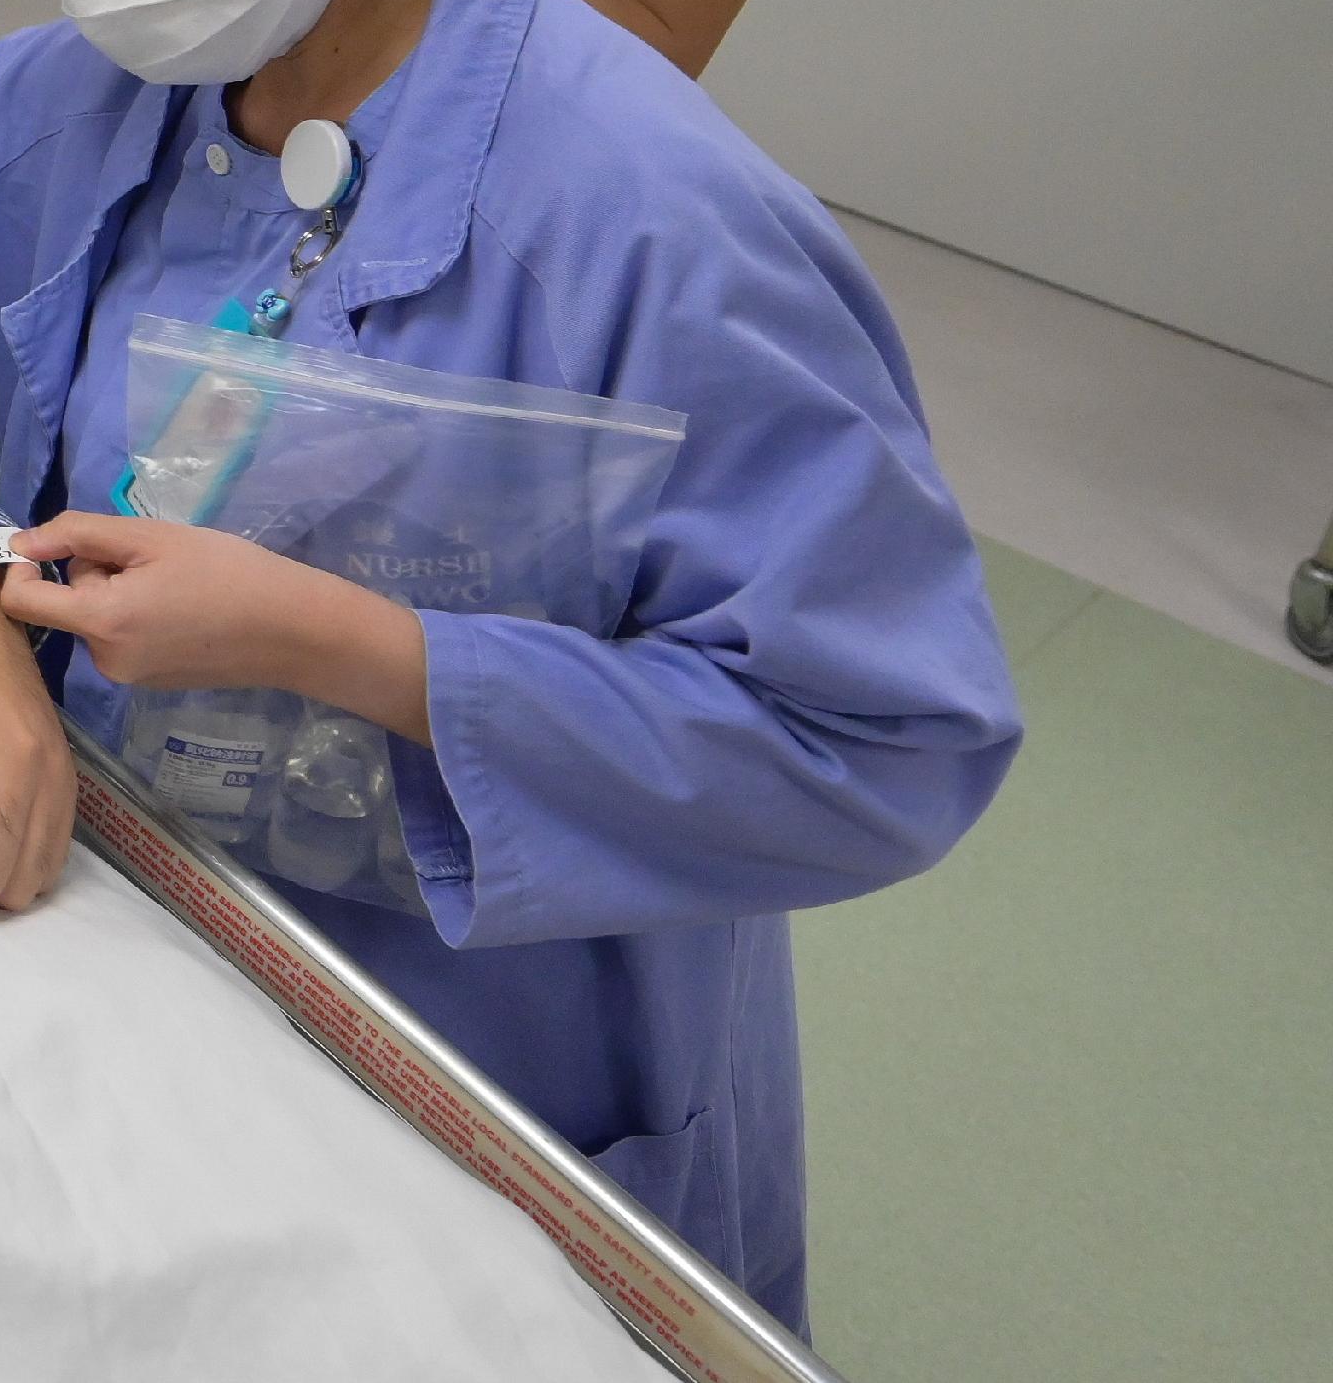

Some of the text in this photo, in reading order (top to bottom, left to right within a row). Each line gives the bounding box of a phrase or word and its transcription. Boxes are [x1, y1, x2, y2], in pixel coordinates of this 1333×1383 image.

[84, 791, 105, 811] NOT
[102, 808, 141, 842] EXCEED
[138, 839, 161, 860] THE
[158, 856, 207, 900] MAXIMUM
[204, 897, 249, 938] LOADING
[246, 934, 288, 973] WEIGHT
[301, 983, 362, 1038] DESCRIBED
[373, 1046, 399, 1071] THE
[397, 1067, 431, 1098] USER
[428, 1095, 480, 1141] MANUAL
[94, 787, 121, 811] ONLY
[119, 808, 140, 828] THE
[137, 824, 177, 860] WEIGHT
[175, 857, 198, 879] YOU
[195, 875, 219, 898] CAN
[258, 931, 303, 971] HANDLE
[300, 967, 363, 1023] COMPLIANT
[379, 1036, 404, 1060] THE
[401, 1056, 472, 1119] APPLICABLE
[469, 1115, 511, 1154] LOCAL
[508, 1150, 576, 1210] STANDARD
[573, 1207, 603, 1234] AND
[600, 1231, 652, 1277] SAFETY
[651, 1275, 698, 1317] RULES
